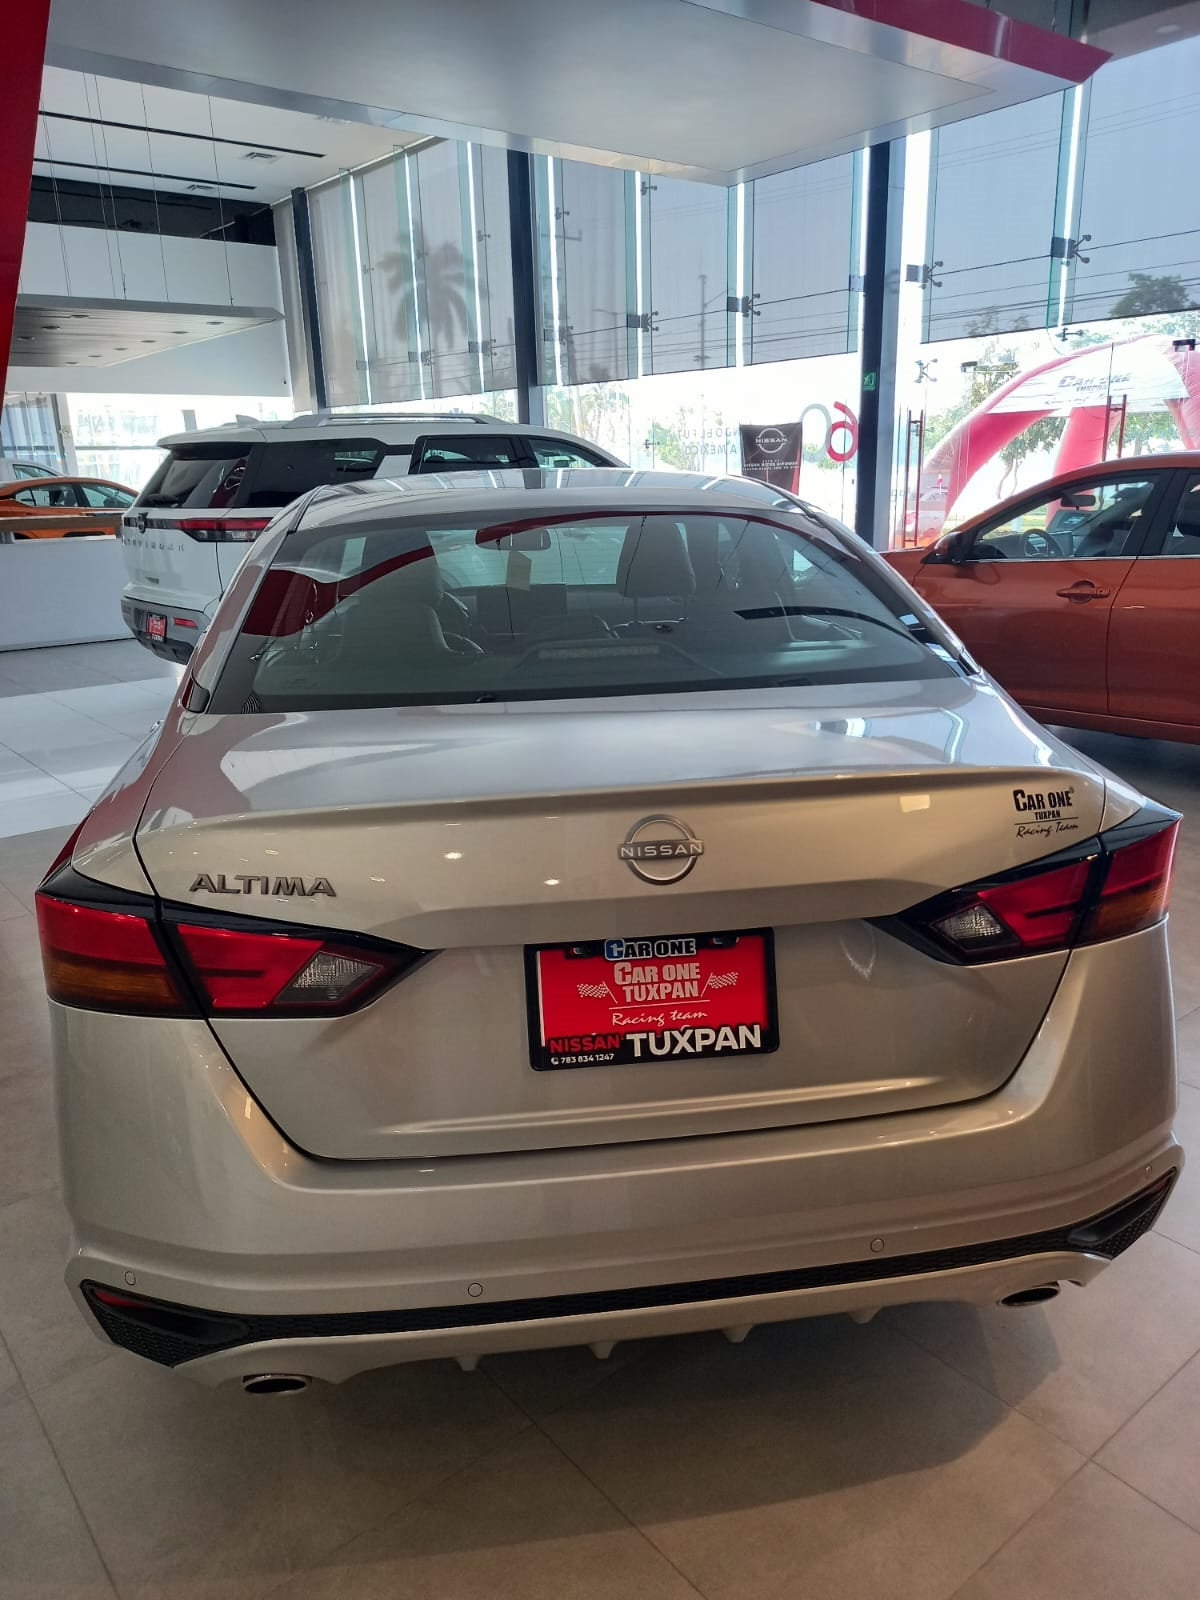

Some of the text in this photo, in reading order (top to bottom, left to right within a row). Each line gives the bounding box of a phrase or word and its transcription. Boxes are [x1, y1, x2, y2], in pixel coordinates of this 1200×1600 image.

[1013, 789, 1073, 812] CAR ONE
[1034, 810, 1061, 821] TUXPAN
[1016, 821, 1079, 838] Racing Team
[621, 843, 703, 857] NISSAN
[188, 873, 337, 897] ALTIMA
[604, 938, 697, 961] CAR ONE
[614, 962, 701, 985] CAR ONE
[622, 980, 699, 1003] TUXPAN
[612, 1009, 708, 1027] Racing team
[549, 1024, 761, 1057] NISSAN TUXPAN
[560, 1053, 615, 1064] 783 834 1247
